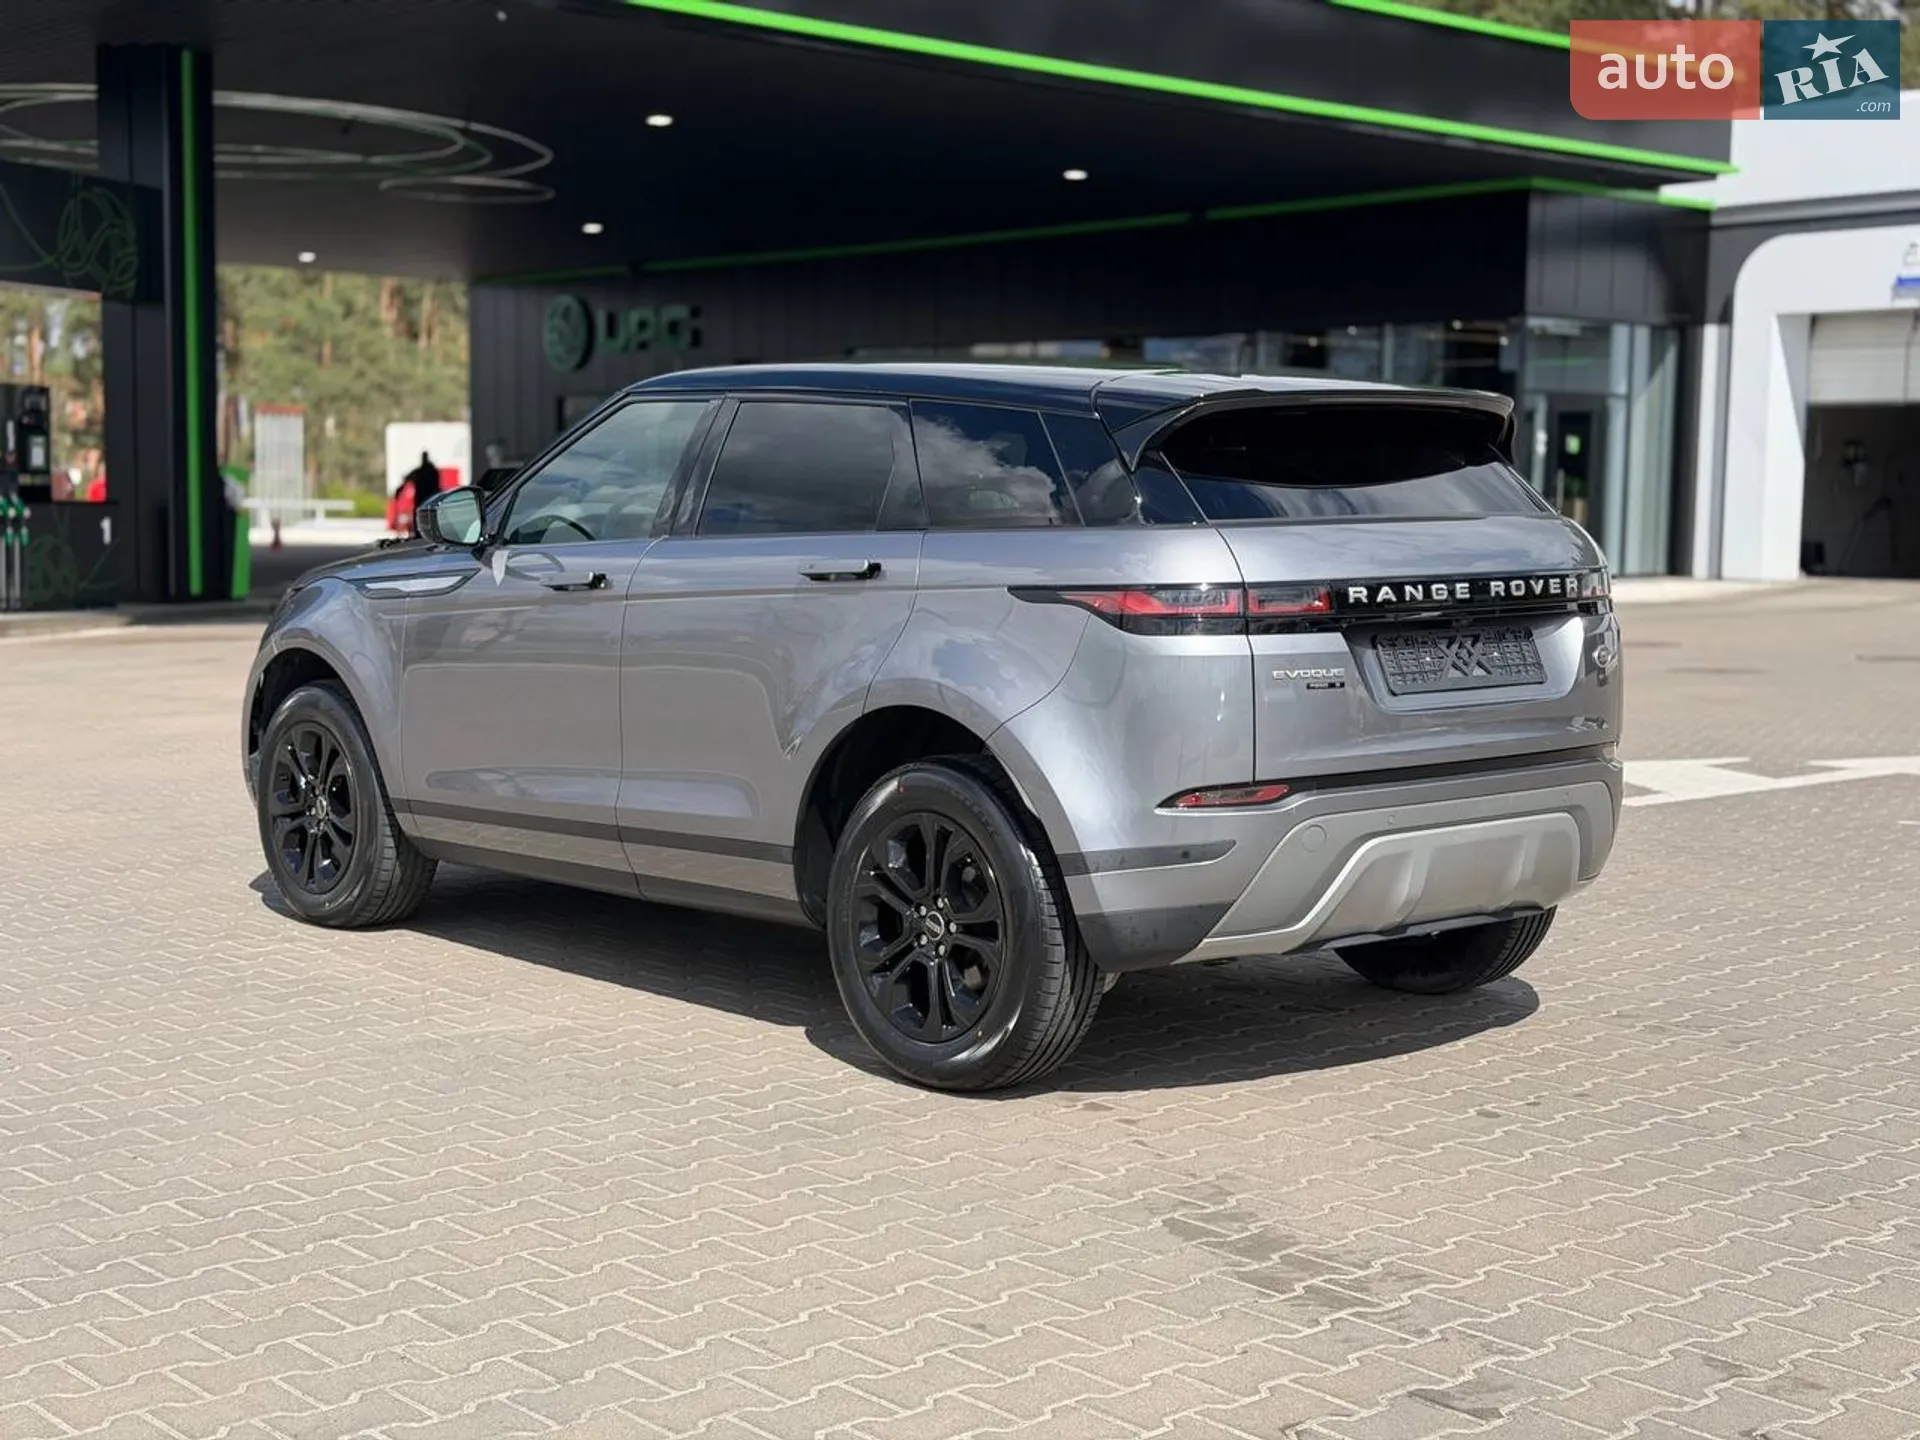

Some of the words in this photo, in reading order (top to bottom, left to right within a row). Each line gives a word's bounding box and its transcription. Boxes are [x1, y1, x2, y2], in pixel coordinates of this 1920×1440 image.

[100, 516, 112, 545] 1
[1348, 582, 1471, 604] RANGE
[1490, 577, 1579, 598] ROVER
[1272, 667, 1345, 680] EVOQUE
